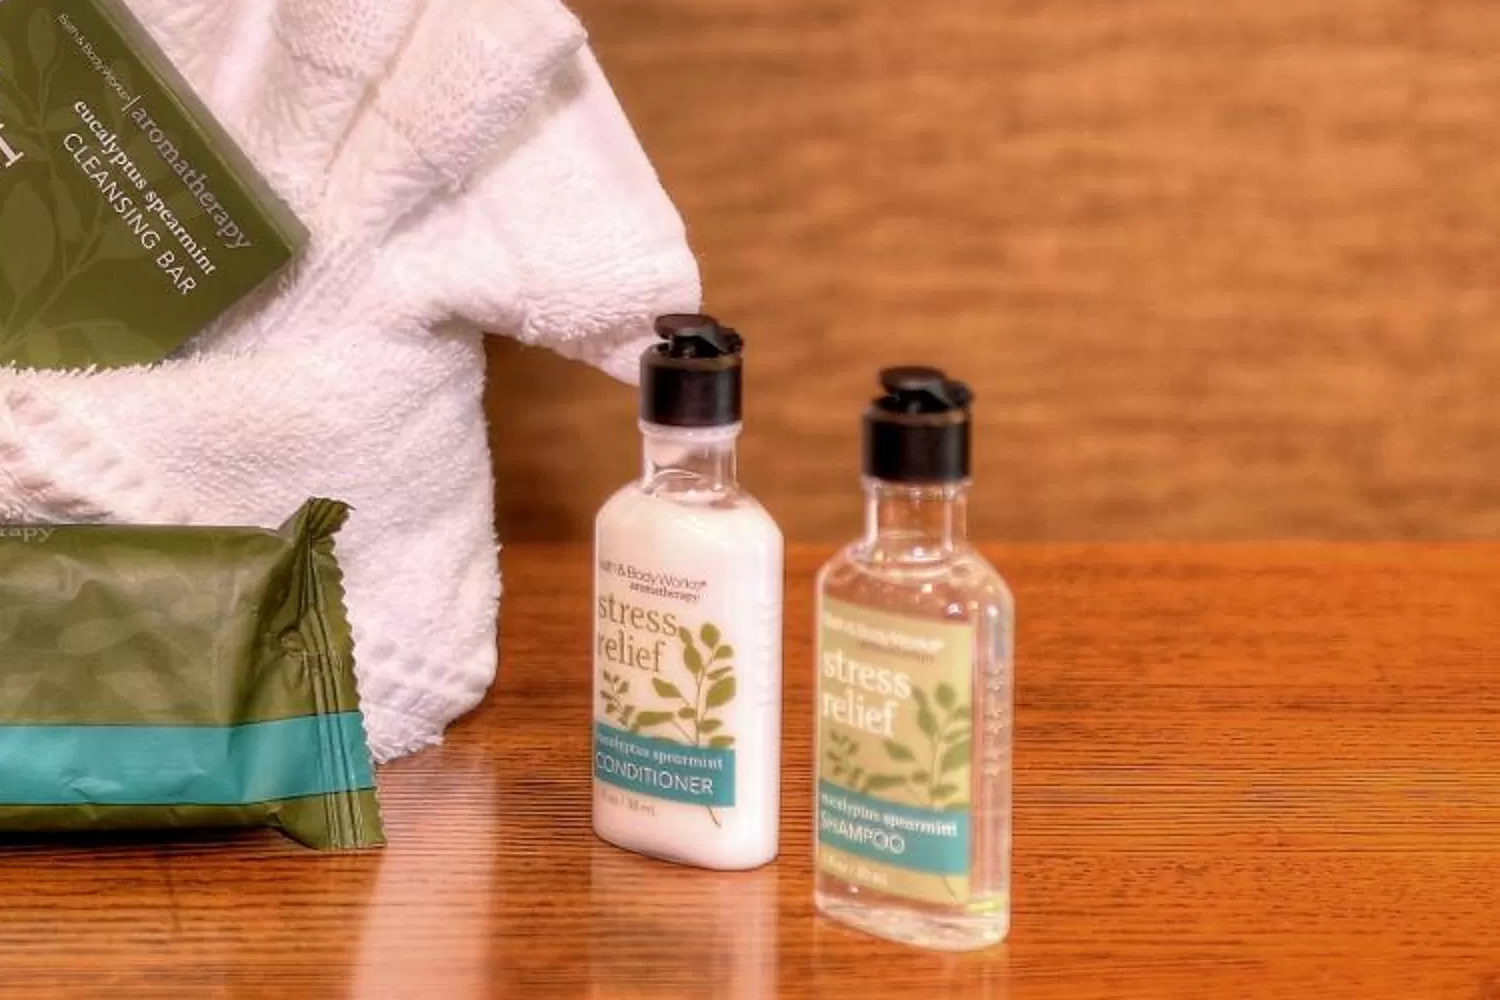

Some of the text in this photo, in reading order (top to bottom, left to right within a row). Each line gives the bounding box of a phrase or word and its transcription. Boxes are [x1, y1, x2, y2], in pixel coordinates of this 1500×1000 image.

[74, 100, 217, 275] eucalyptus spearmint
[131, 107, 252, 249] aromatherapy
[63, 133, 198, 296] CLEANSING BAR
[598, 593, 677, 637] stress
[598, 628, 667, 673] relief
[823, 648, 912, 699] stress
[822, 688, 898, 738] relief
[596, 751, 714, 796] CONDITIONER
[821, 809, 905, 854] SHAMPOO
[882, 814, 957, 837] spearmint
